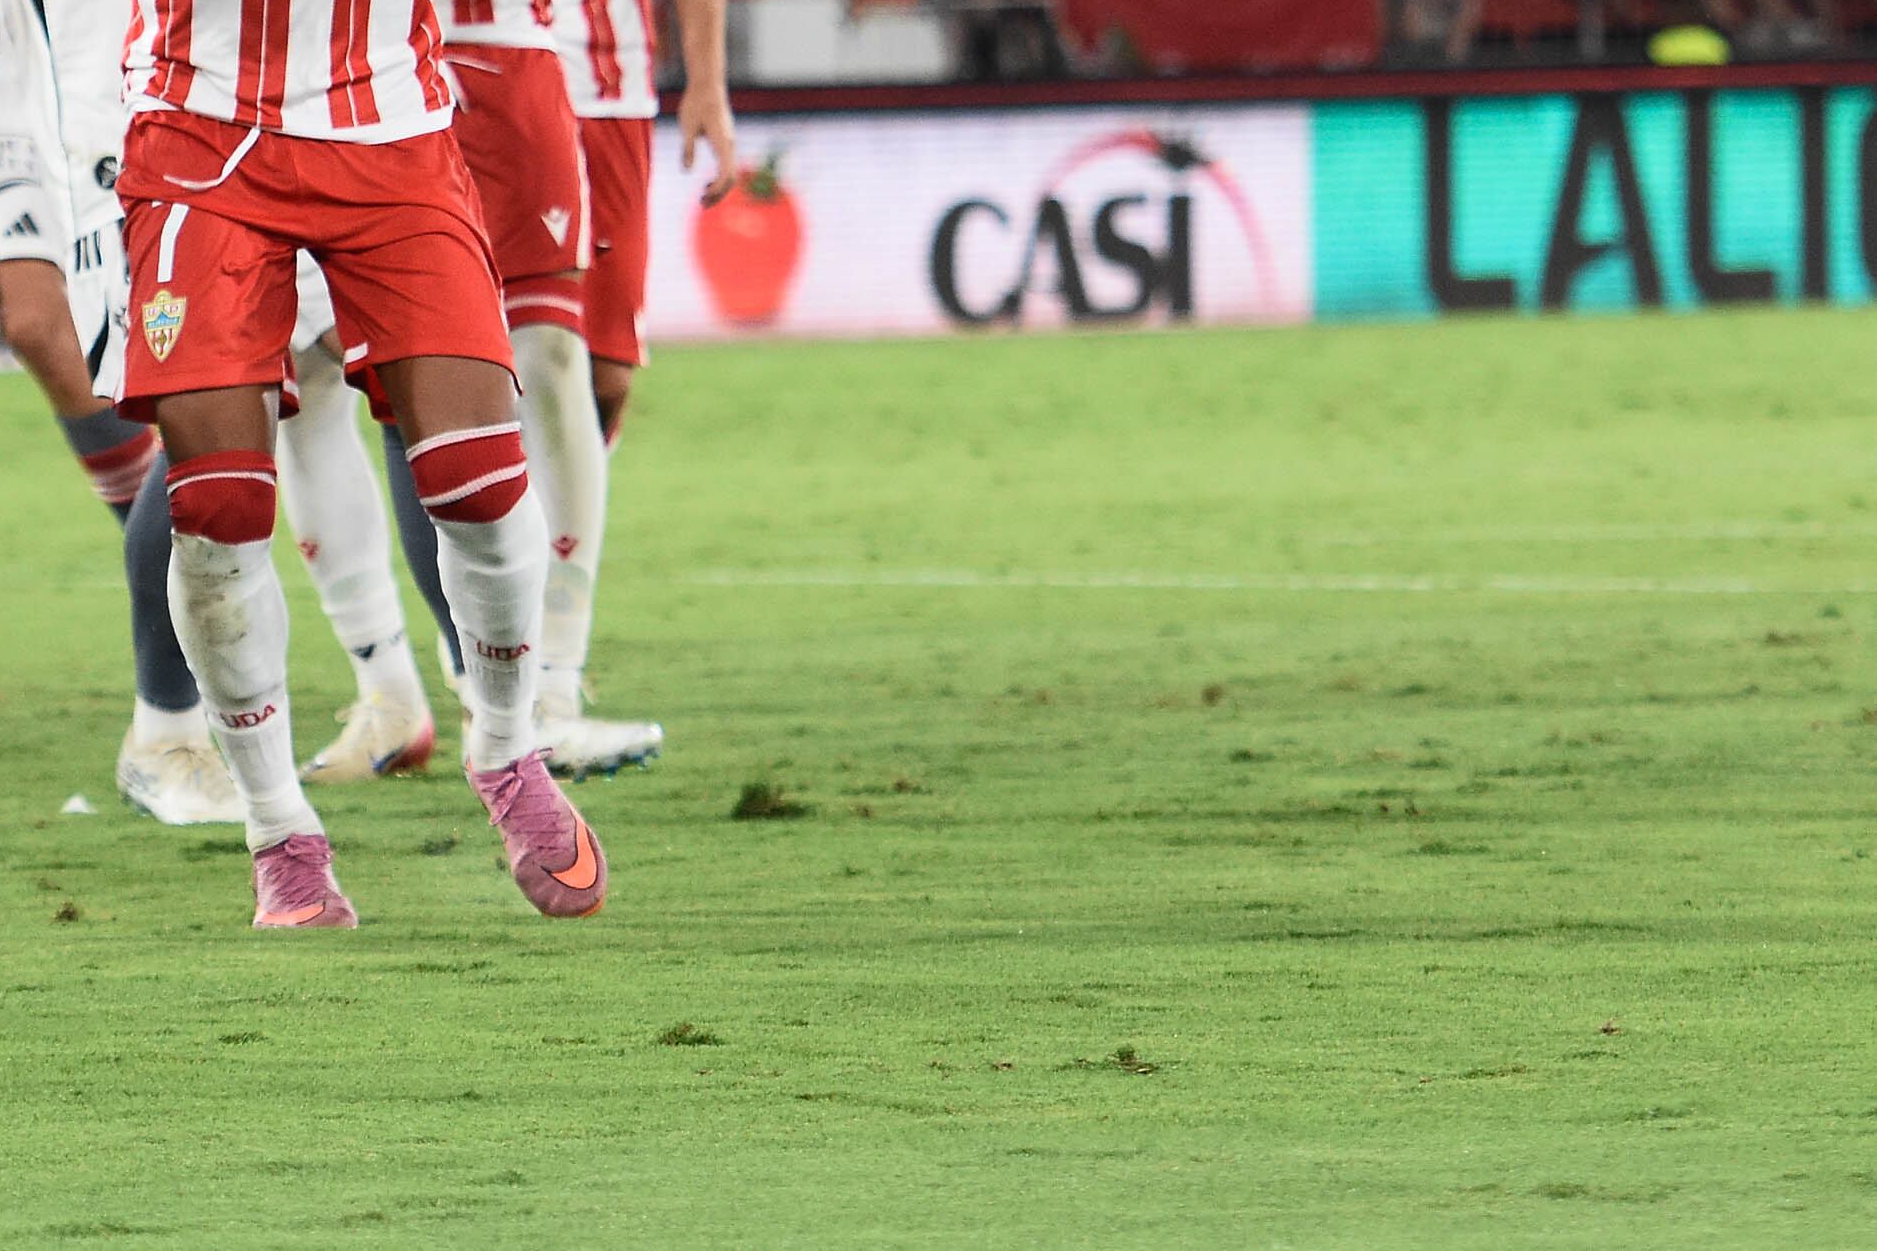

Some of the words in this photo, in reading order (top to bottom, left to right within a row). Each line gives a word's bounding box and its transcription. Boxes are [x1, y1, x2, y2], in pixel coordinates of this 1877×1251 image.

[930, 193, 1192, 321] CASI
[1425, 88, 1877, 310] LALI
[219, 704, 276, 728] UDA
